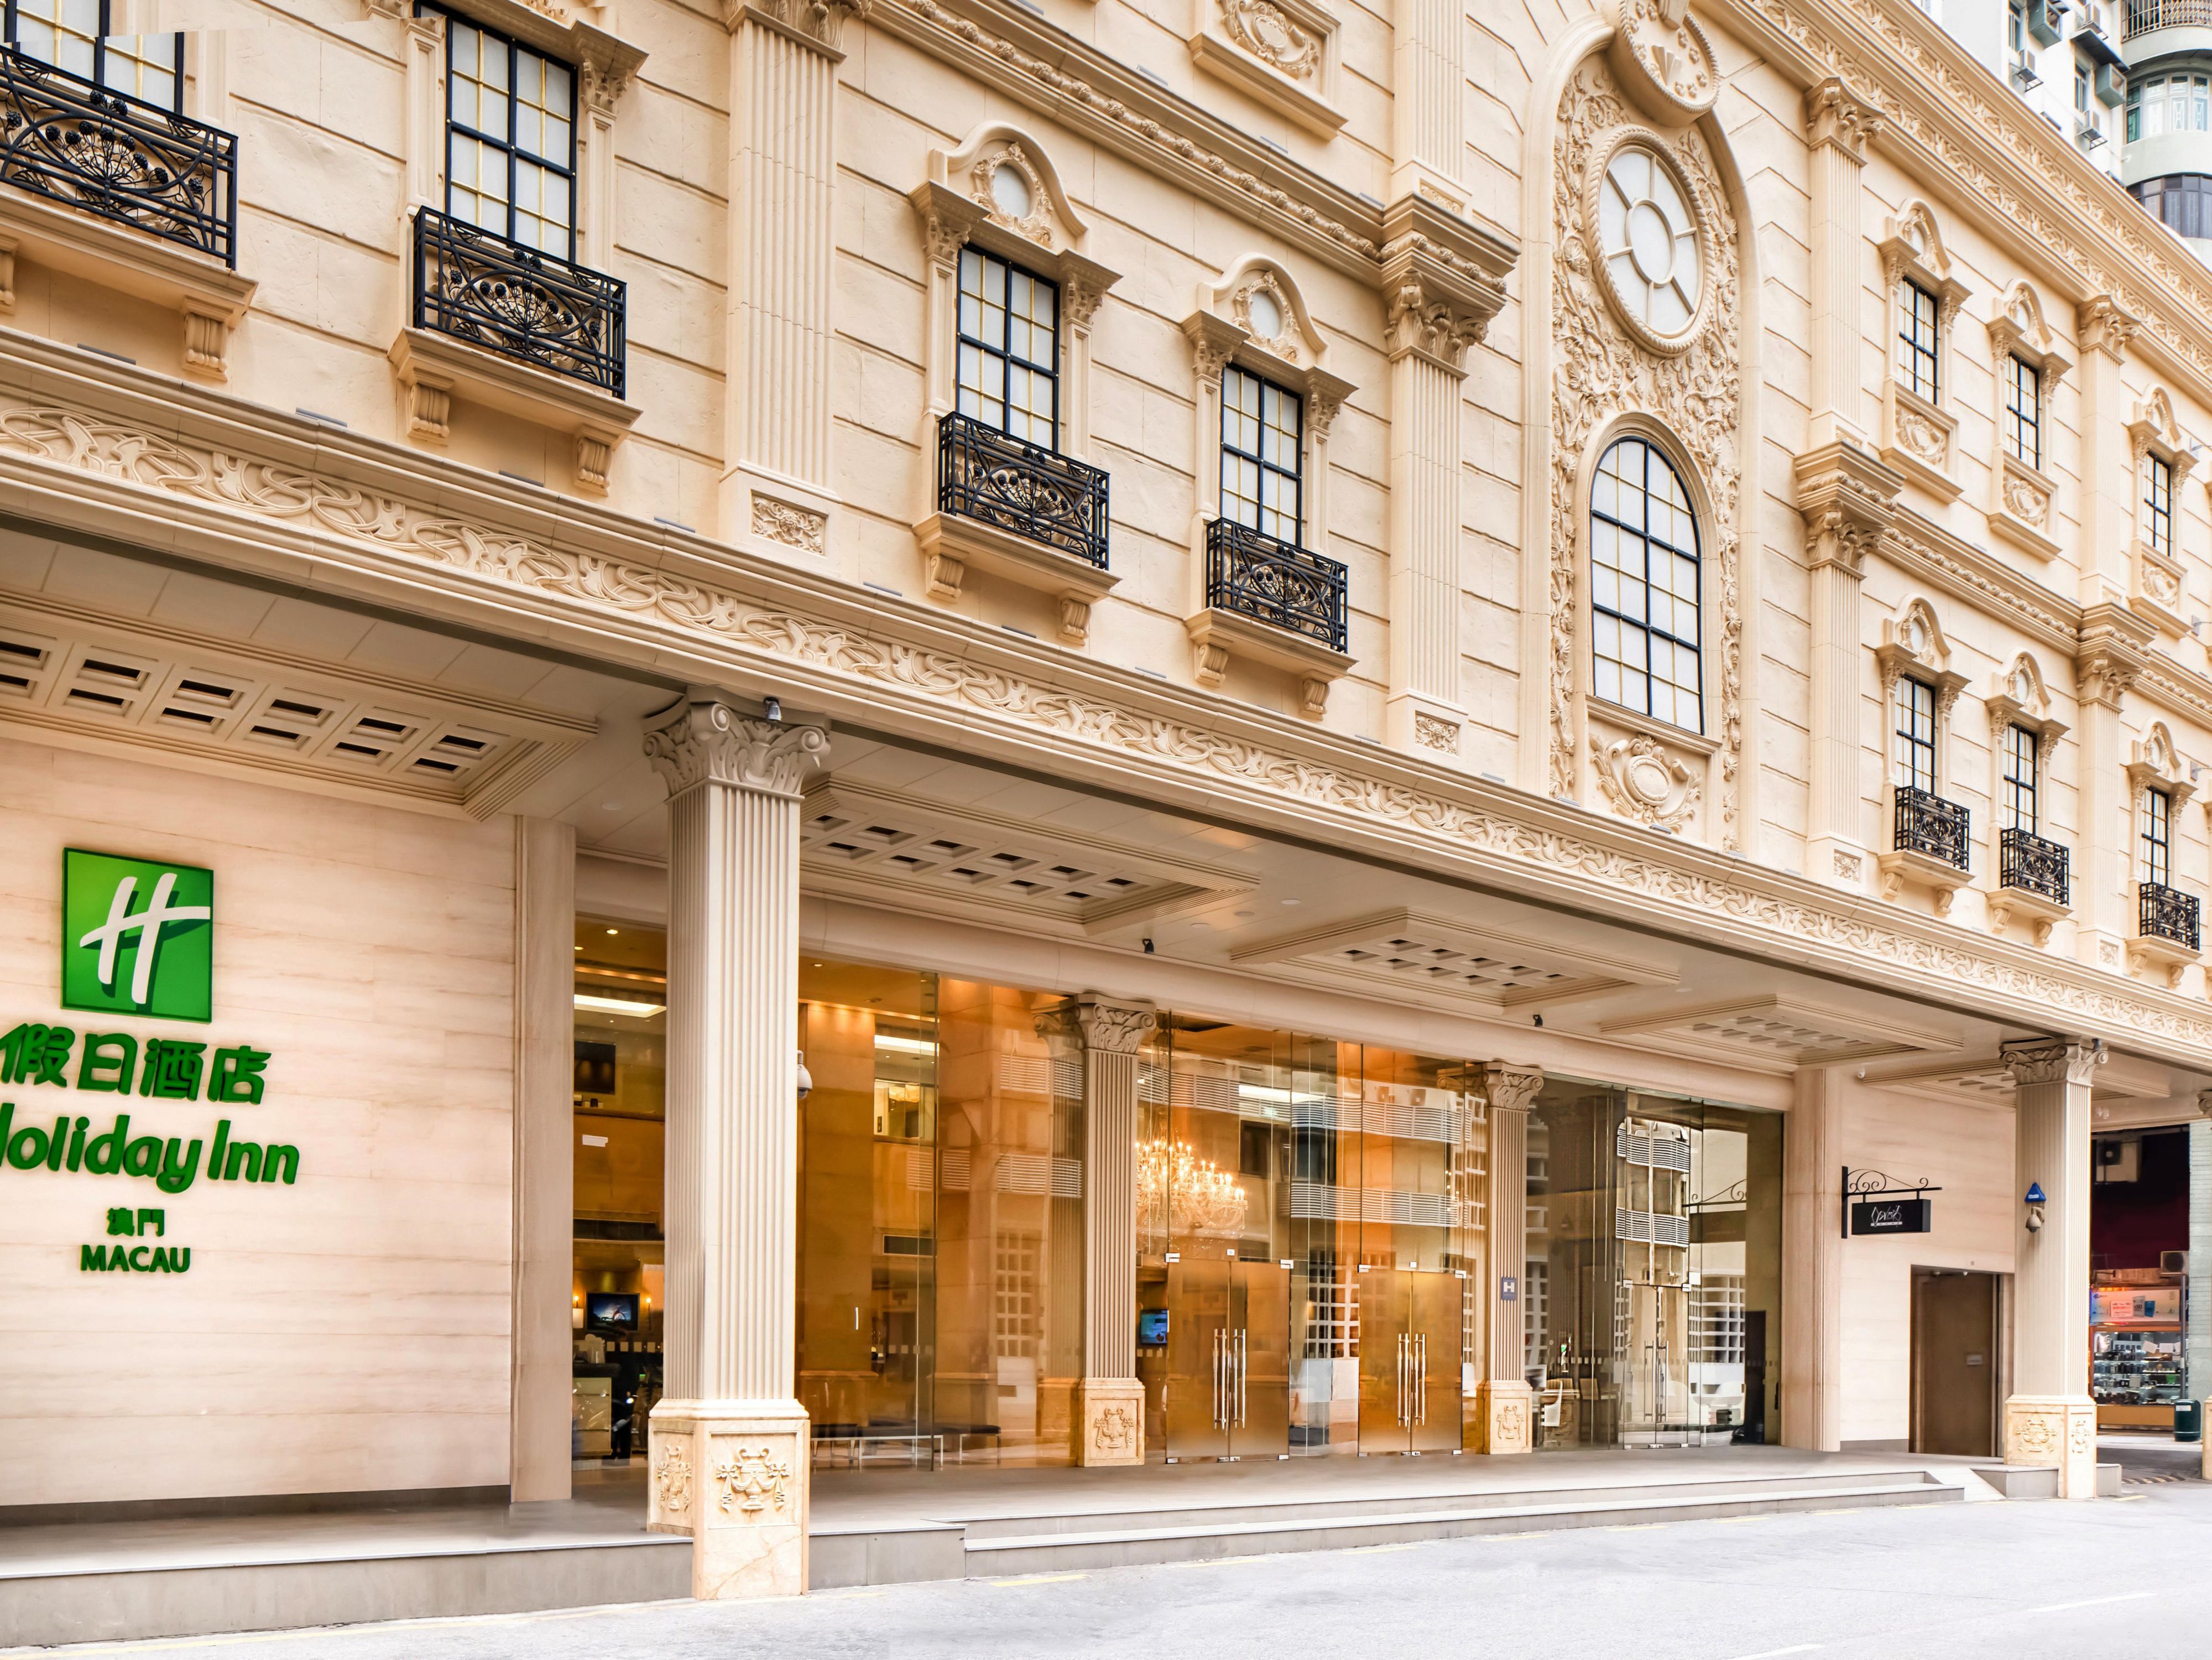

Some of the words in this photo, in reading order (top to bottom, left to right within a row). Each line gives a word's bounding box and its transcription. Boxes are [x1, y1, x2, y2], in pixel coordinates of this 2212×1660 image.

[0, 1023, 272, 1105] 假日酒店
[207, 1119, 300, 1185] Inn
[107, 1207, 165, 1237] 澳門
[81, 1245, 191, 1273] MACAU
[1504, 1282, 1515, 1293] H
